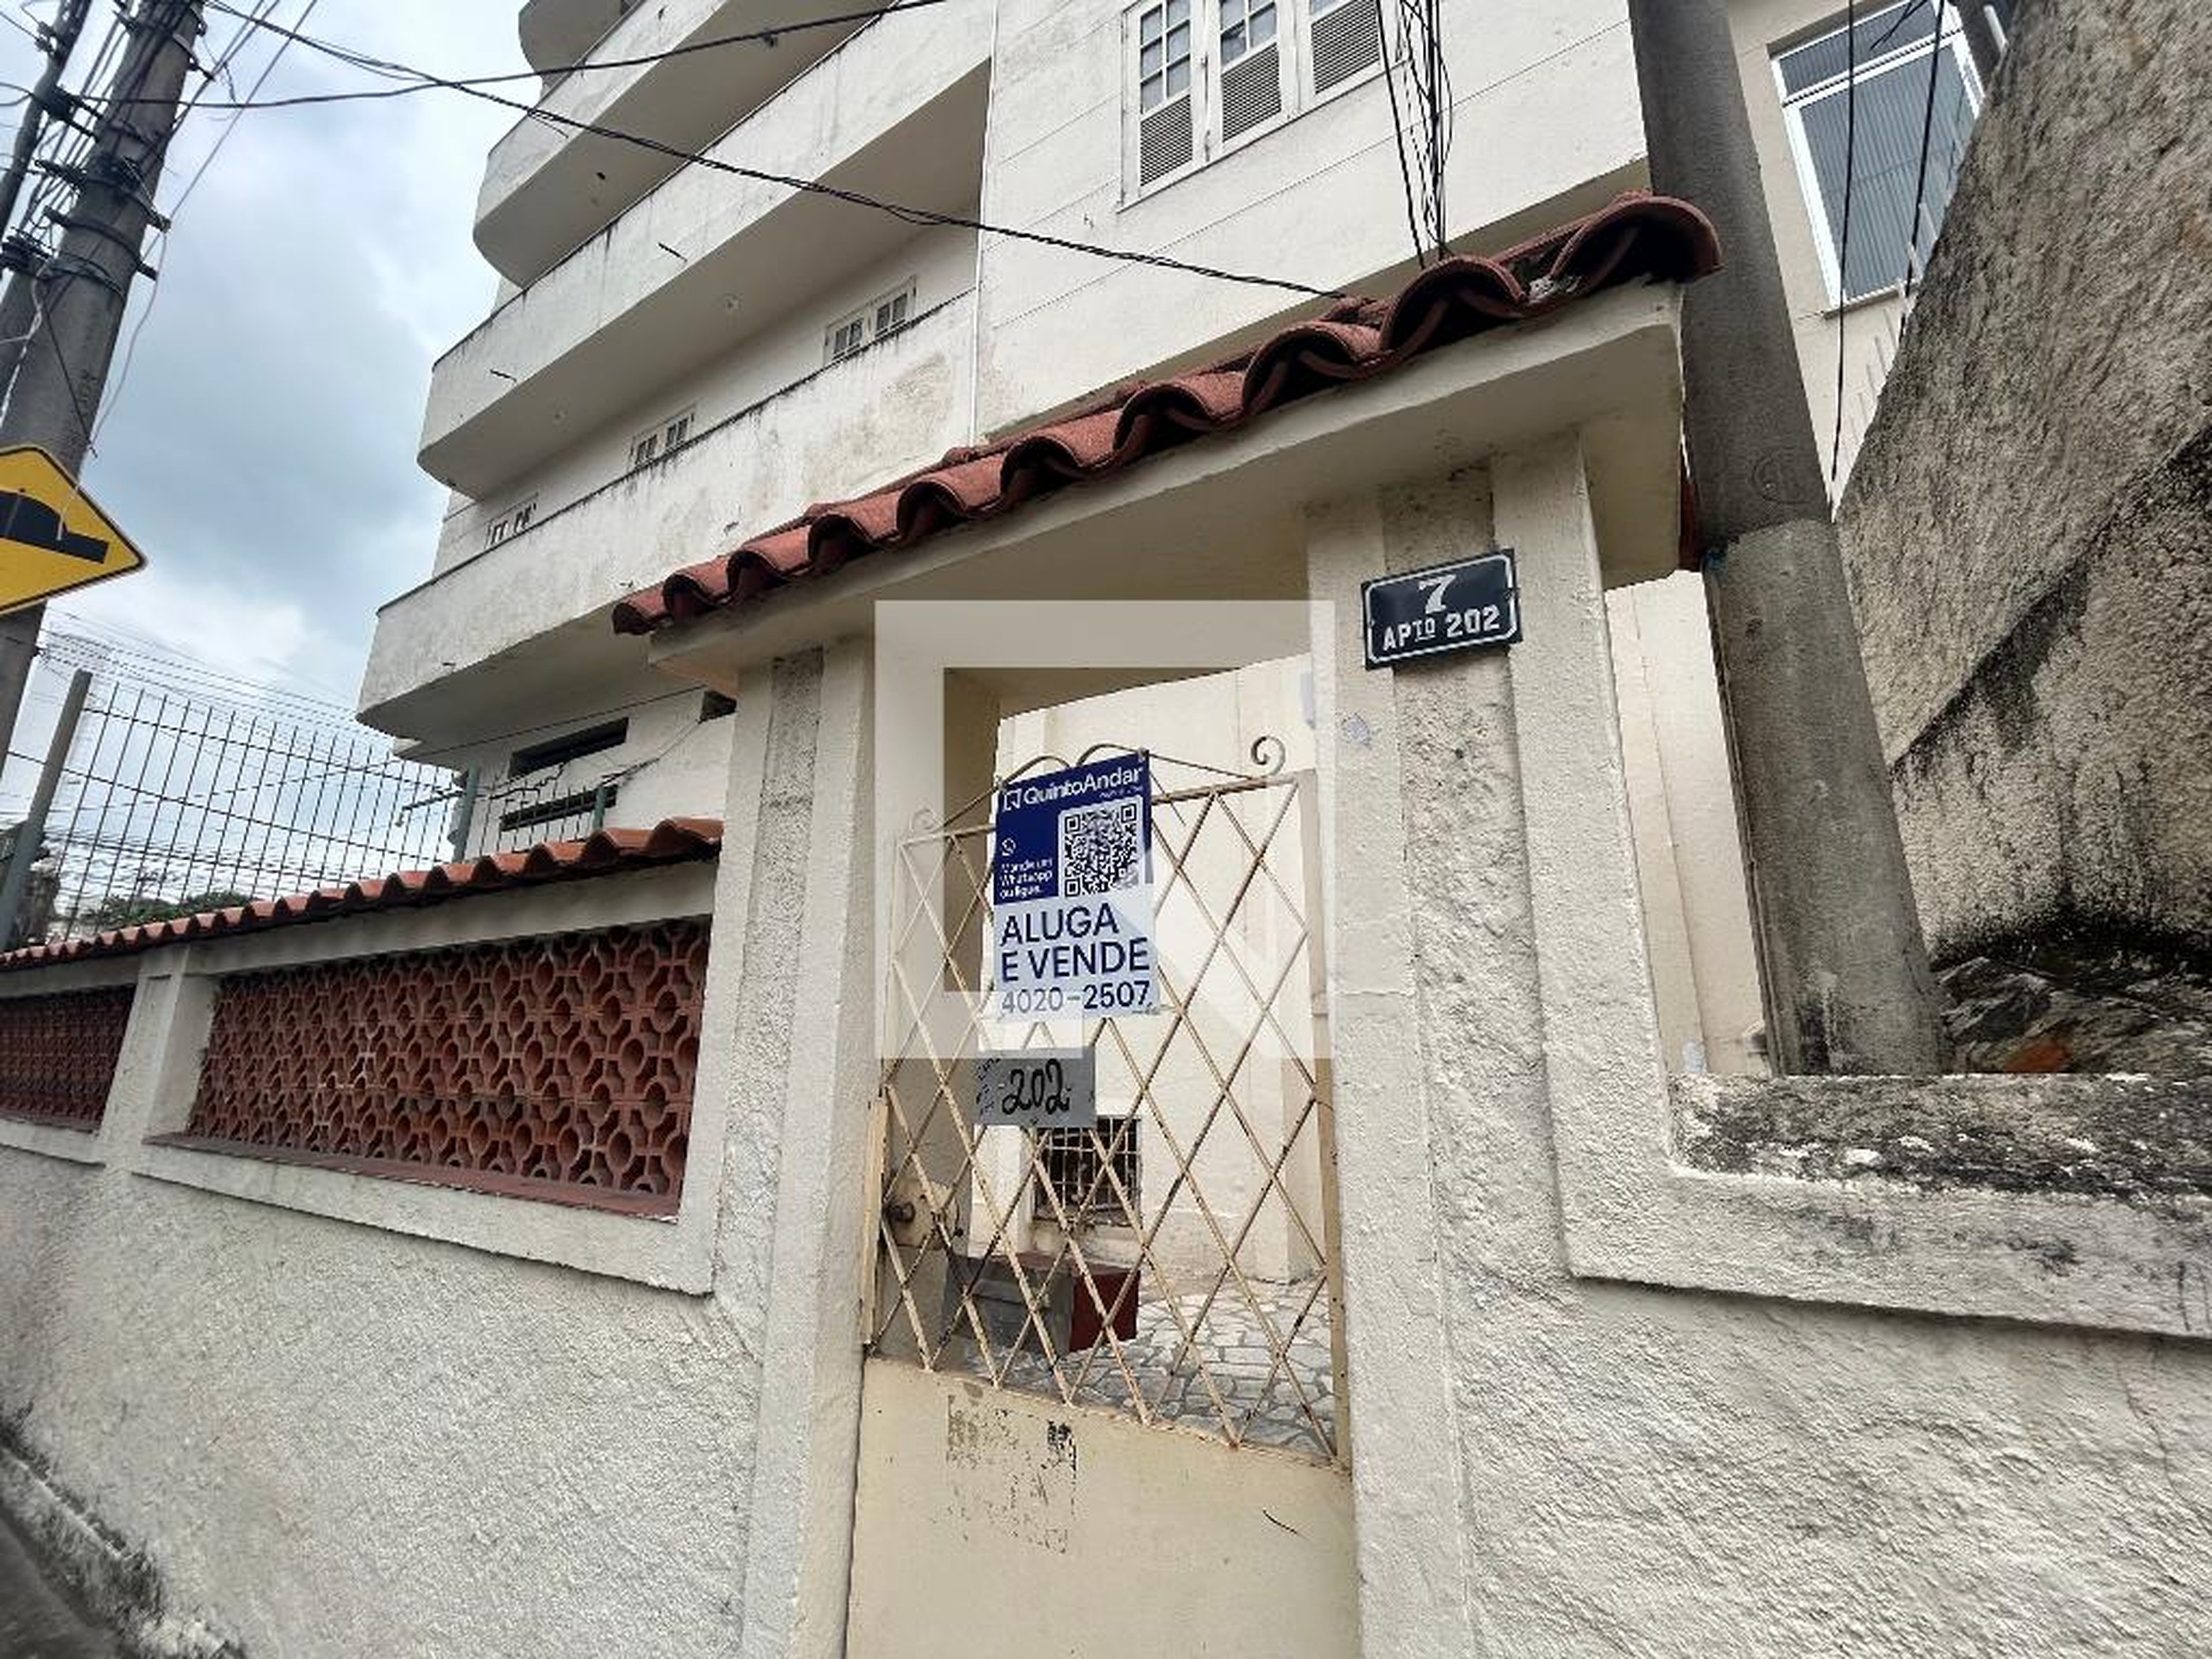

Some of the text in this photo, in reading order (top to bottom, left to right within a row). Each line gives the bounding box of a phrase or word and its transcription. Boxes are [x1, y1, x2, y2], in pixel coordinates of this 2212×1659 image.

[1418, 574, 1456, 613] 7
[1445, 604, 1500, 638] 202
[1024, 766, 1143, 804] QuintoAndar
[1000, 903, 1119, 946] ALUGA
[1002, 937, 1150, 982] E VENDE
[1001, 980, 1150, 1013] 4020-2507
